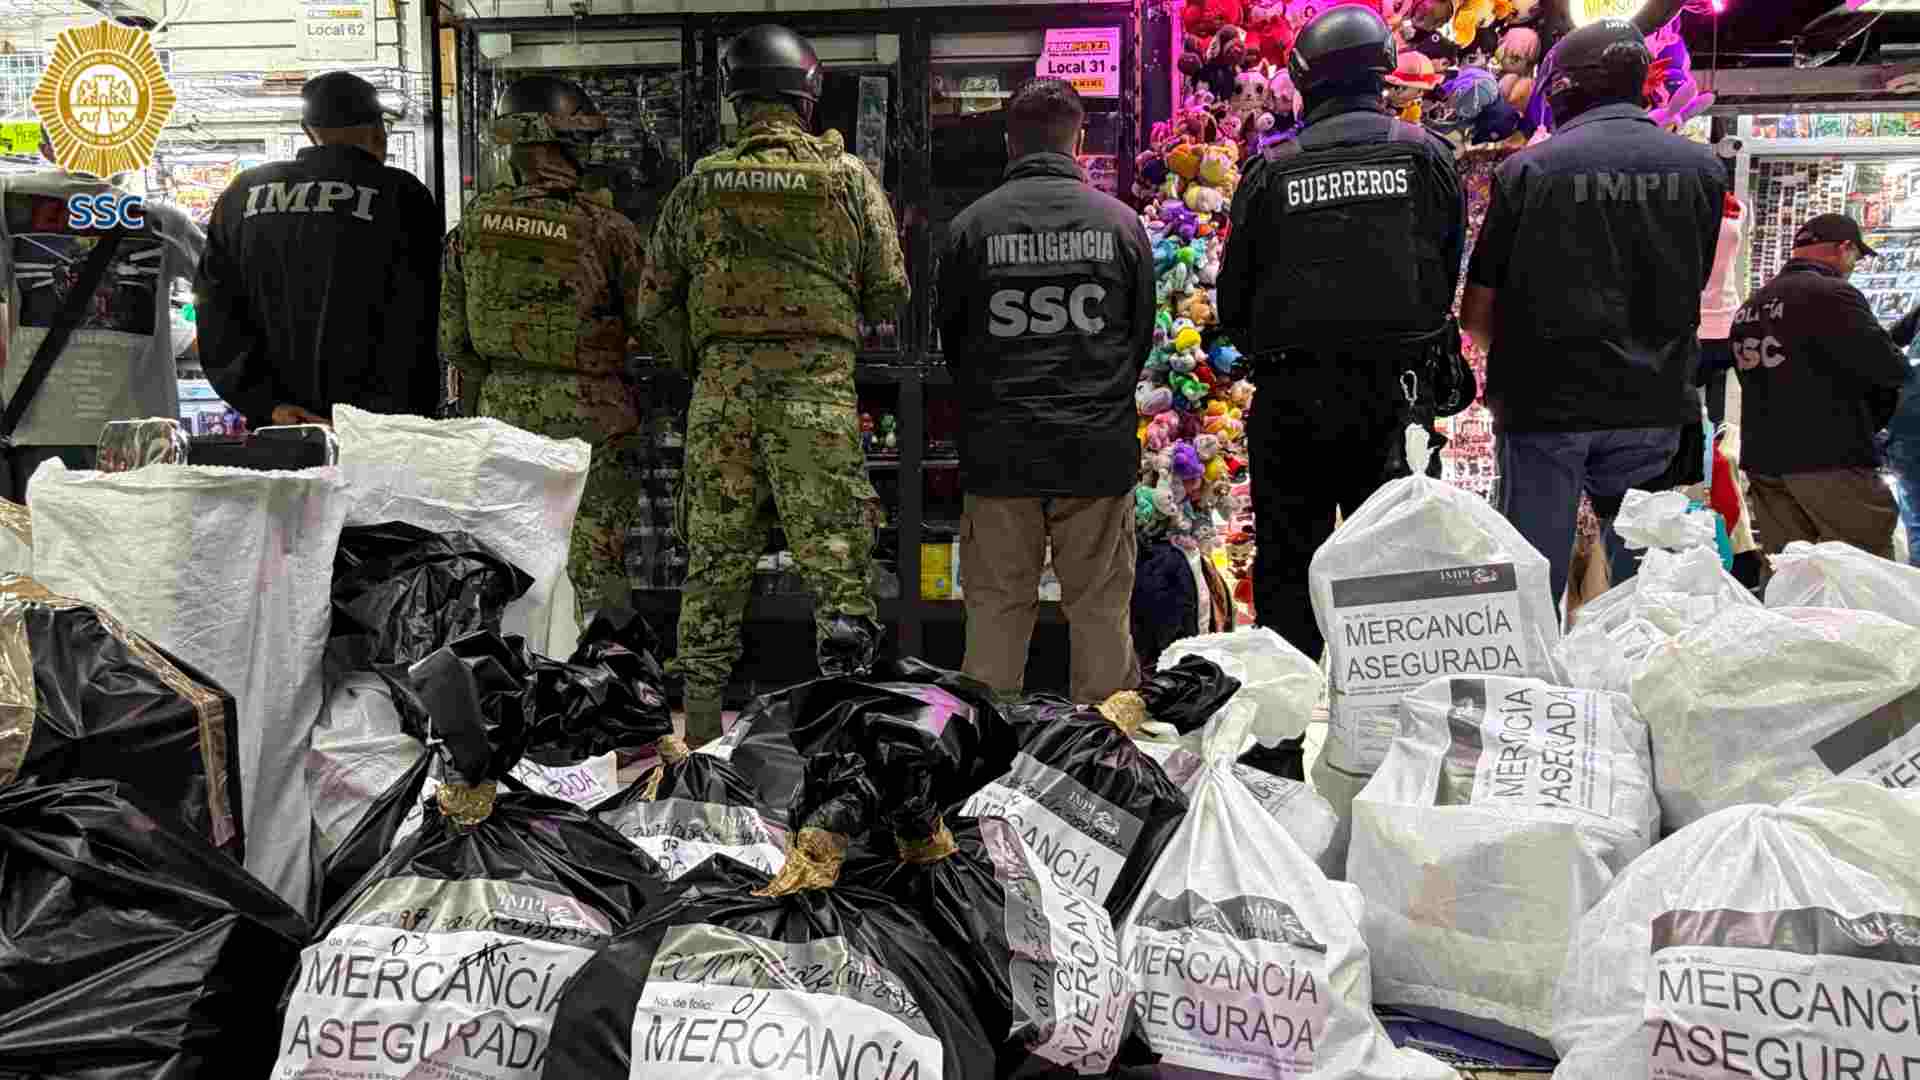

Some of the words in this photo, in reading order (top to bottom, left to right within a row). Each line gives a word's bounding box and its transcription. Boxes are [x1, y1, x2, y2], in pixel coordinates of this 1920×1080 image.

[306, 24, 345, 37] Local
[1047, 60, 1086, 74] Local
[1089, 60, 1105, 73] 31
[712, 170, 809, 192] MARINA
[1286, 168, 1409, 206] GUERREROS
[1574, 172, 1680, 203] IMPI
[243, 181, 379, 222] IMPI
[481, 213, 569, 240] MARINA
[987, 230, 1115, 265] INTELIGENCIA
[988, 283, 1107, 337] SSC
[1344, 604, 1513, 647] MERCANCÍA
[1347, 644, 1523, 681] ASEGURADA
[1124, 944, 1318, 1004] MERCANCÍA
[287, 1014, 547, 1070] ASEGURAD
